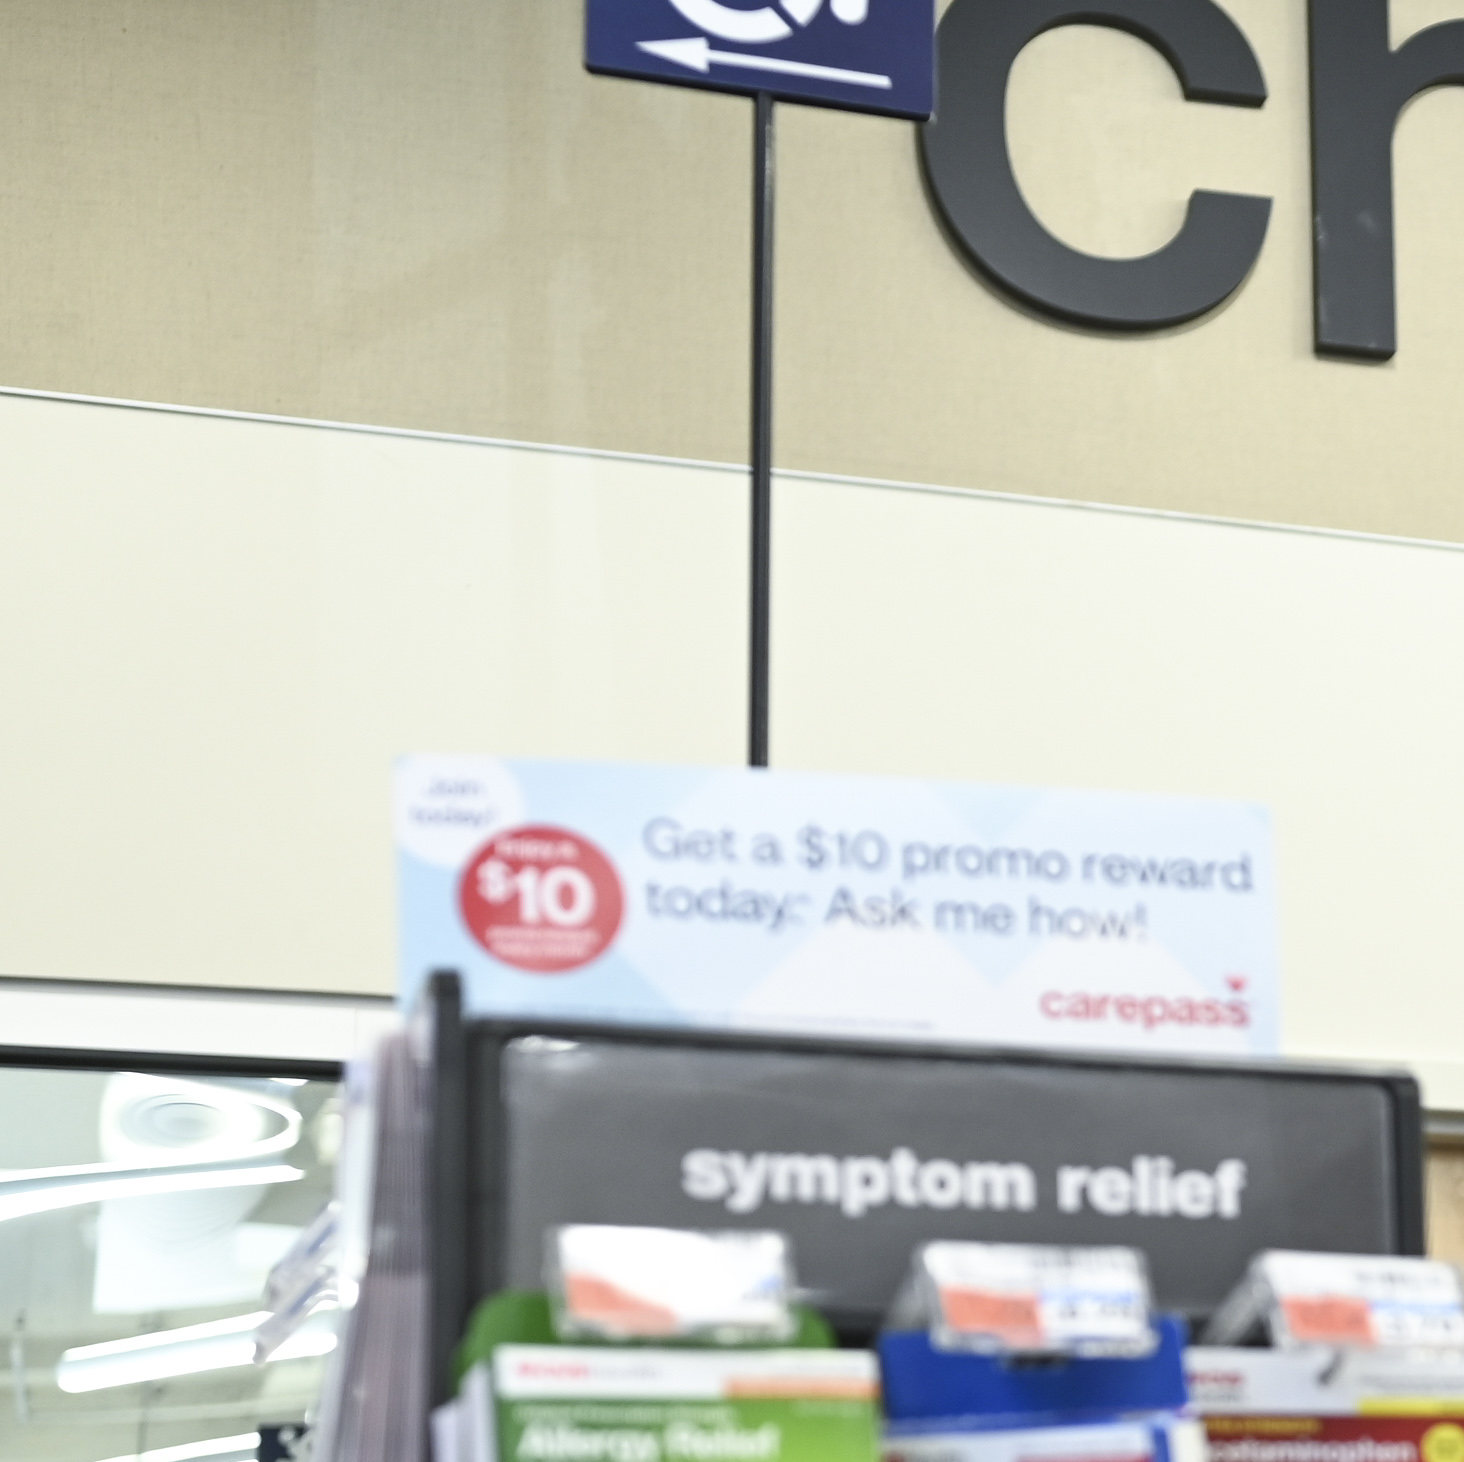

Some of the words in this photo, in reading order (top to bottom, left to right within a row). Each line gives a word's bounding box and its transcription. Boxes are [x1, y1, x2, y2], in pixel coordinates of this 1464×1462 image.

[642, 816, 737, 862] Get
[751, 833, 784, 864] a
[798, 823, 889, 872] $10
[902, 840, 1072, 883] promo
[1081, 852, 1256, 894] reward
[476, 856, 596, 927] $10
[824, 887, 919, 930] Ask
[934, 899, 1017, 937] me
[1029, 895, 1148, 941] how!
[1040, 988, 1252, 1033] carepass
[682, 1148, 1034, 1214] symptom
[1057, 1156, 1243, 1216] relief
